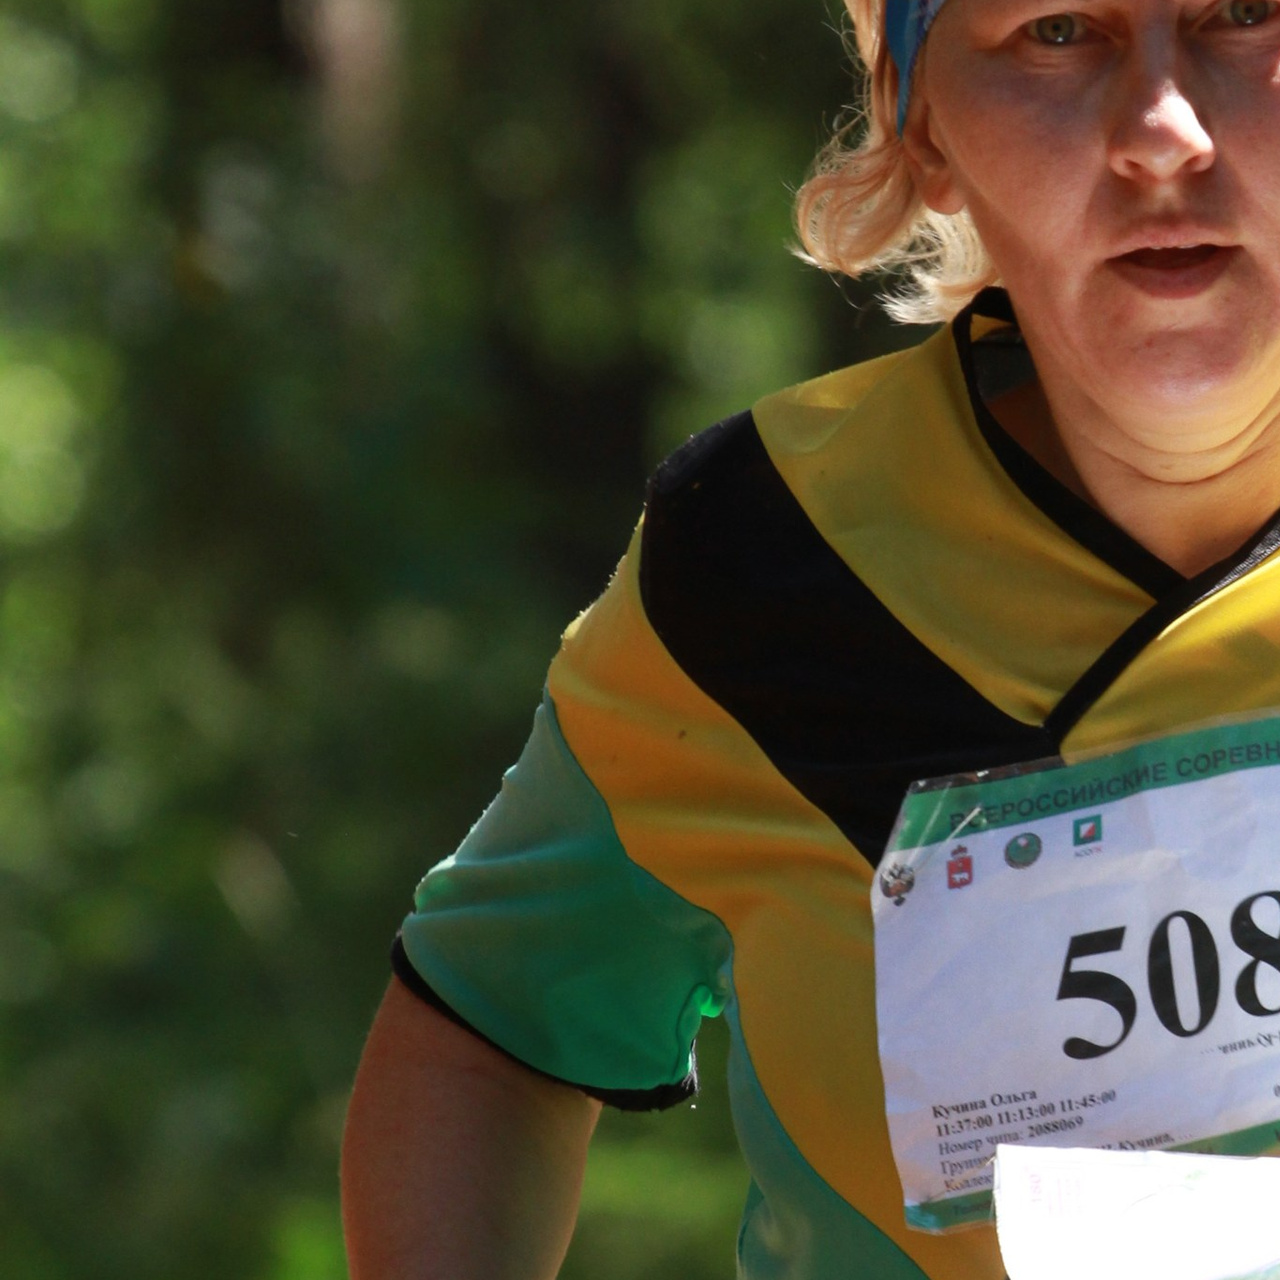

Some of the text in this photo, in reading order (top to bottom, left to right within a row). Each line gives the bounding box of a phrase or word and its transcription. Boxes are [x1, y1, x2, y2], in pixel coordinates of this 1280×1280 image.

[949, 761, 1169, 832] ВСЕРОССИЙСКИЕ
[932, 1090, 1037, 1119] Кучина Ольга
[936, 1090, 1117, 1137] 11:37:00 11:13:00 11:45:00
[938, 1116, 1084, 1156] Номер чипа: 2088069
